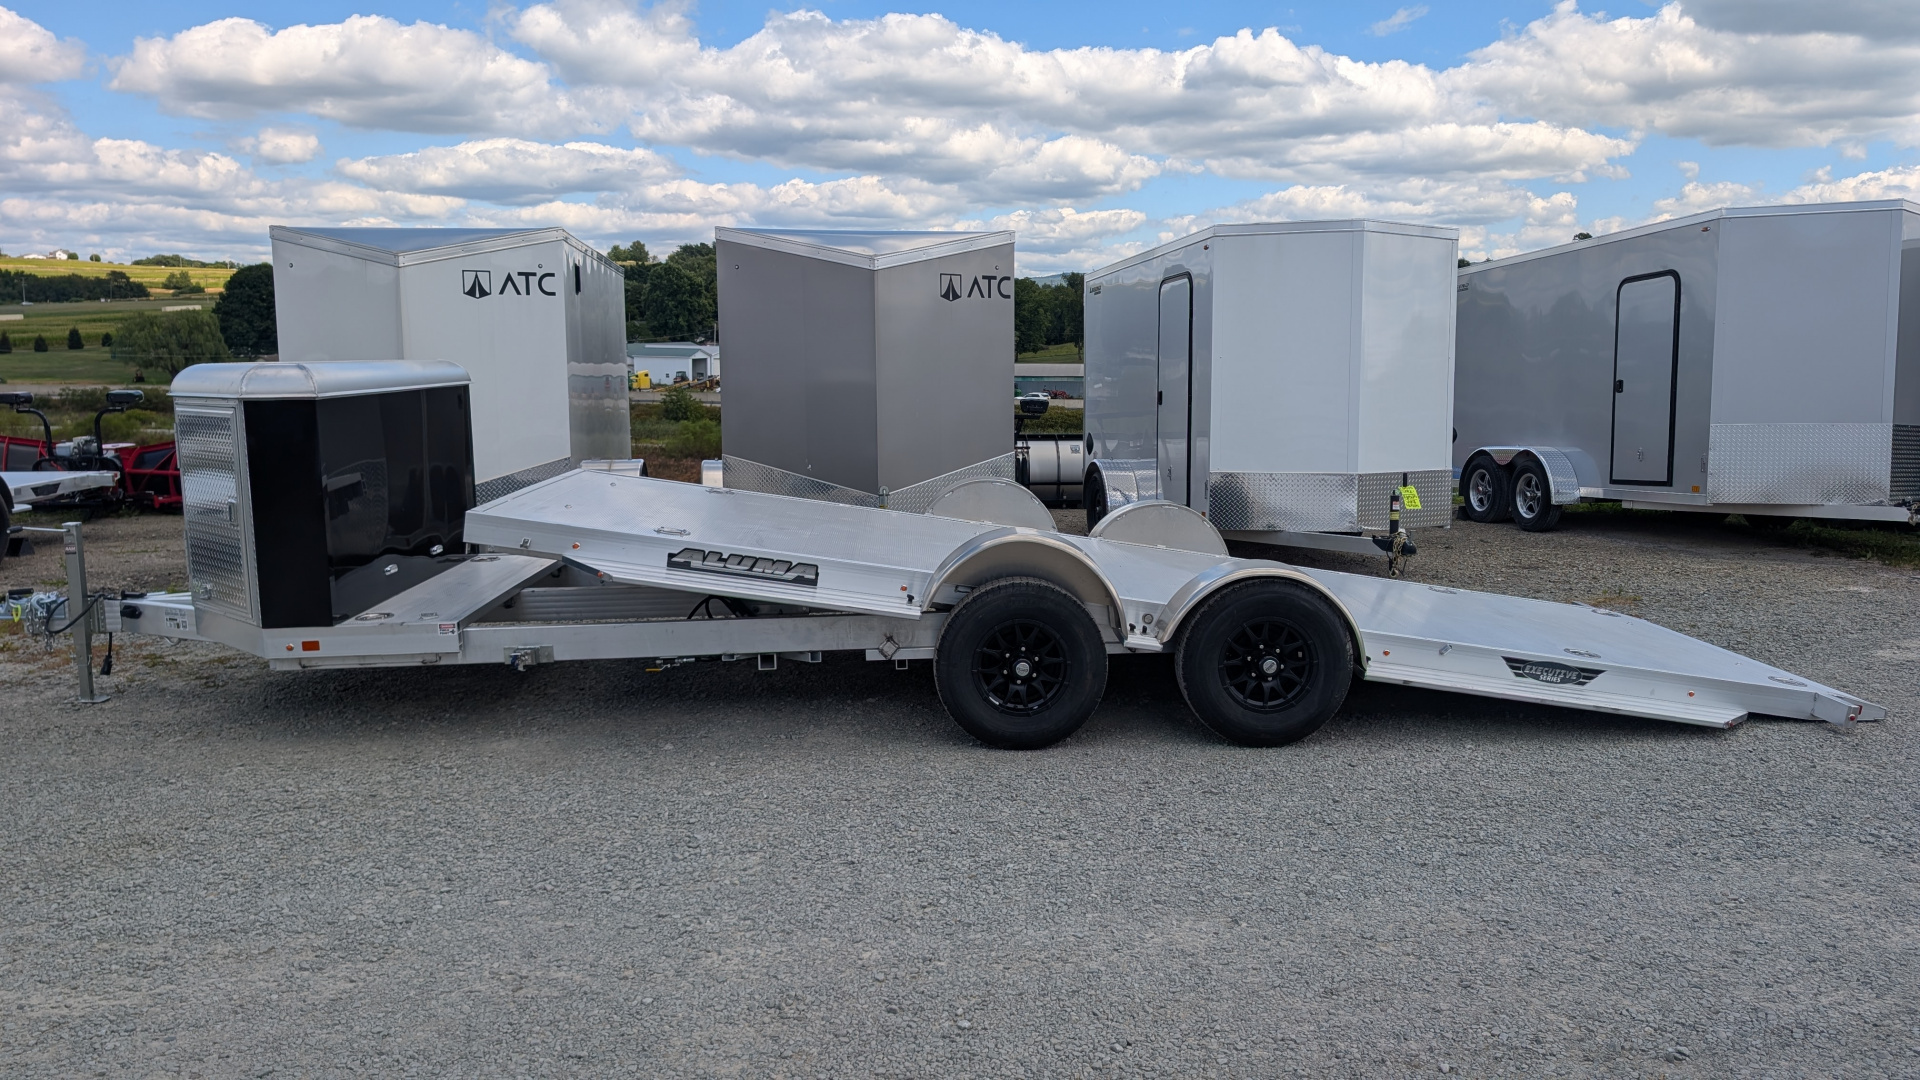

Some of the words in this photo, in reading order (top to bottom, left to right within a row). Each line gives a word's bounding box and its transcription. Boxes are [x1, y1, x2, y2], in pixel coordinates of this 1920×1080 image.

[498, 271, 556, 296] ATC
[966, 275, 1011, 299] ATC
[668, 548, 818, 582] ALUMA
[1523, 665, 1579, 679] EXECUTIVE
[1540, 674, 1561, 682] SERIES
